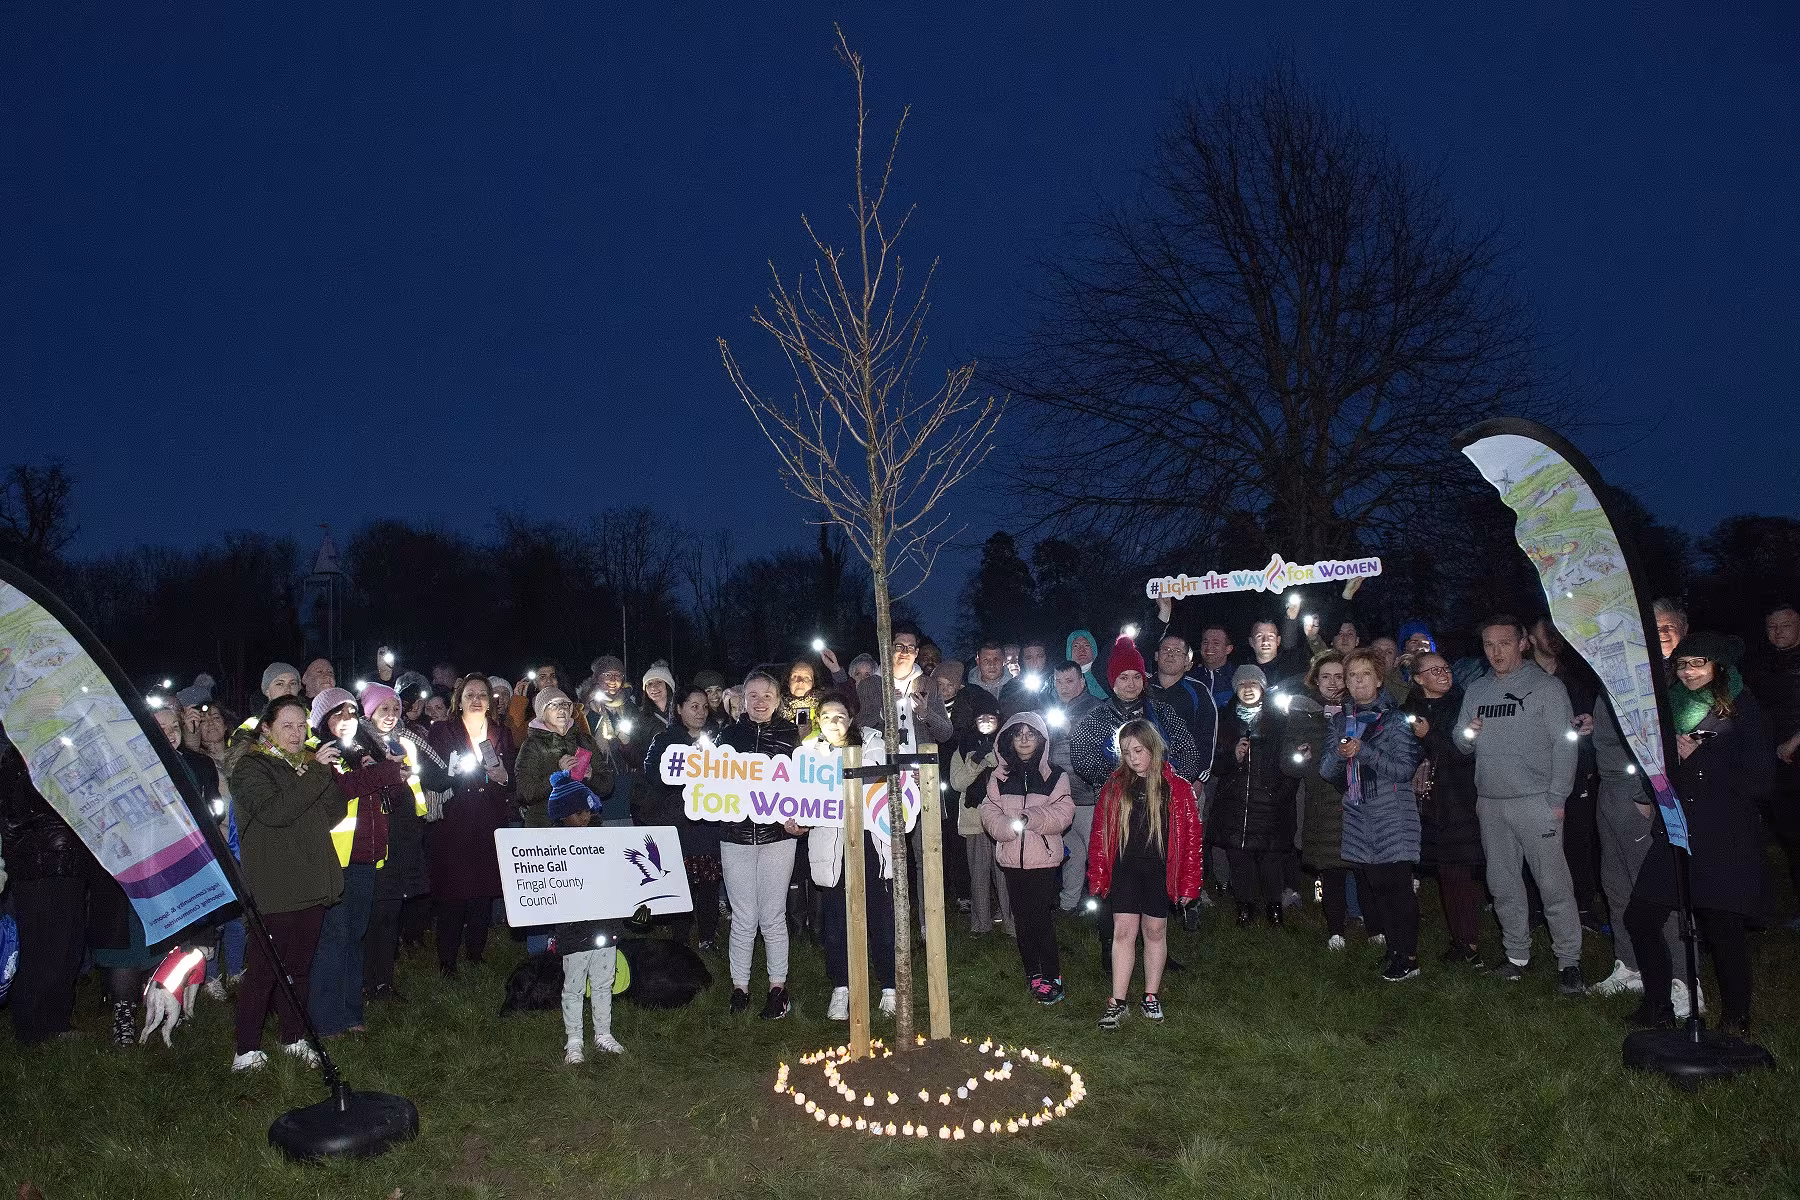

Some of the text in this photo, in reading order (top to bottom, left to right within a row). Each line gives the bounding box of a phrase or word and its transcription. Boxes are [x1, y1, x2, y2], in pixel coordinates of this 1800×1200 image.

[1202, 575, 1228, 590] THE
[1232, 574, 1265, 588] WAY
[1318, 561, 1377, 578] WOMEN
[1477, 703, 1517, 718] PUMA
[772, 762, 790, 783] A
[511, 844, 605, 858] Comhairle Contae
[514, 860, 568, 874] Fhine Gall
[516, 876, 585, 893] Fingal County
[519, 893, 558, 907] Council
